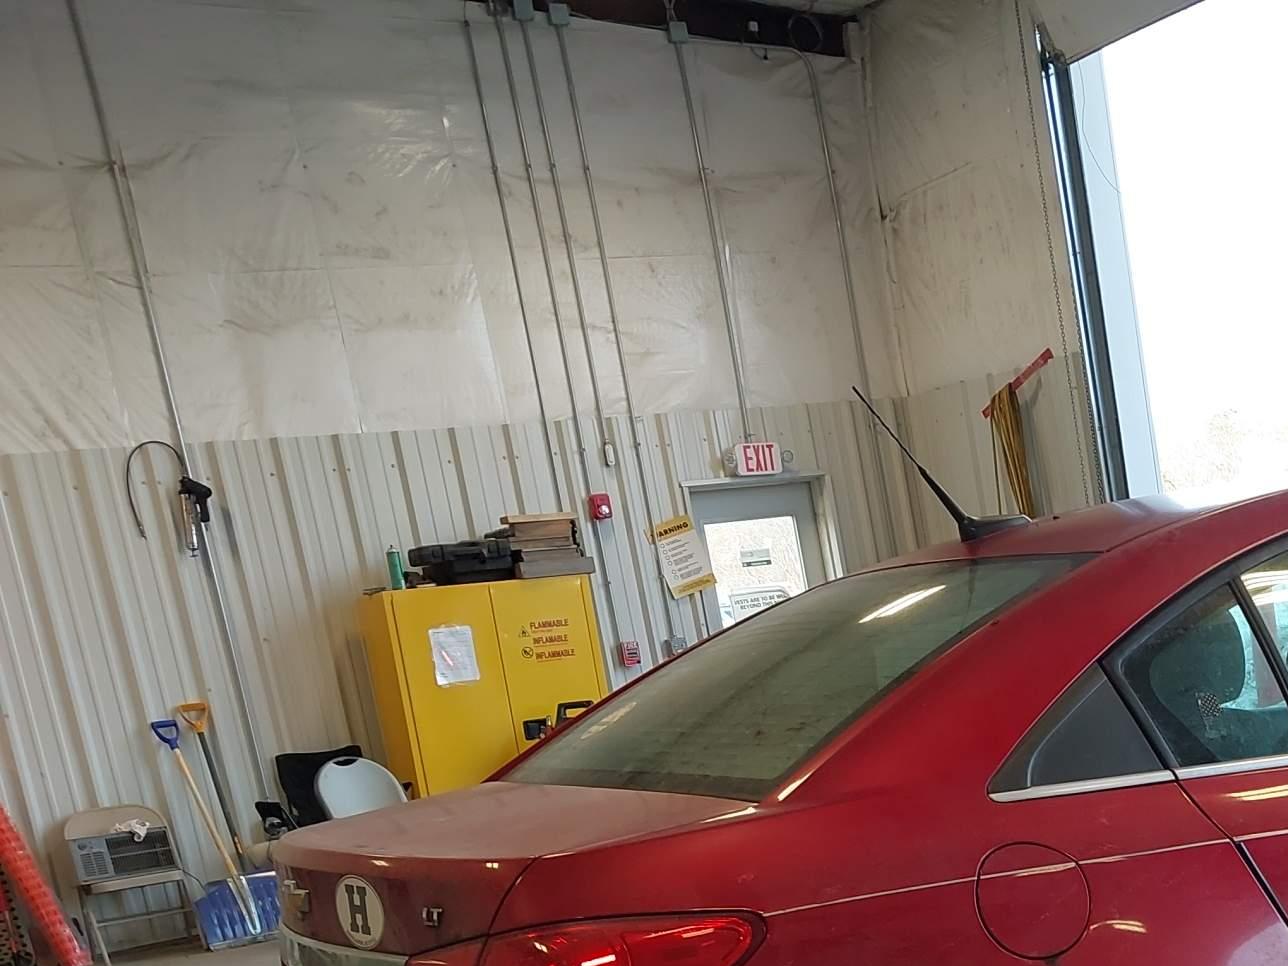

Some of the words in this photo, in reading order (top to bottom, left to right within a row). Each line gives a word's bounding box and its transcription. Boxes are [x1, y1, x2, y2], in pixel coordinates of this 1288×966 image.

[743, 445, 774, 472] EXIT
[529, 618, 569, 631] FLAMMABLE
[536, 649, 576, 660] INFLAMMABLE
[344, 884, 371, 935] H
[422, 907, 442, 927] LT
